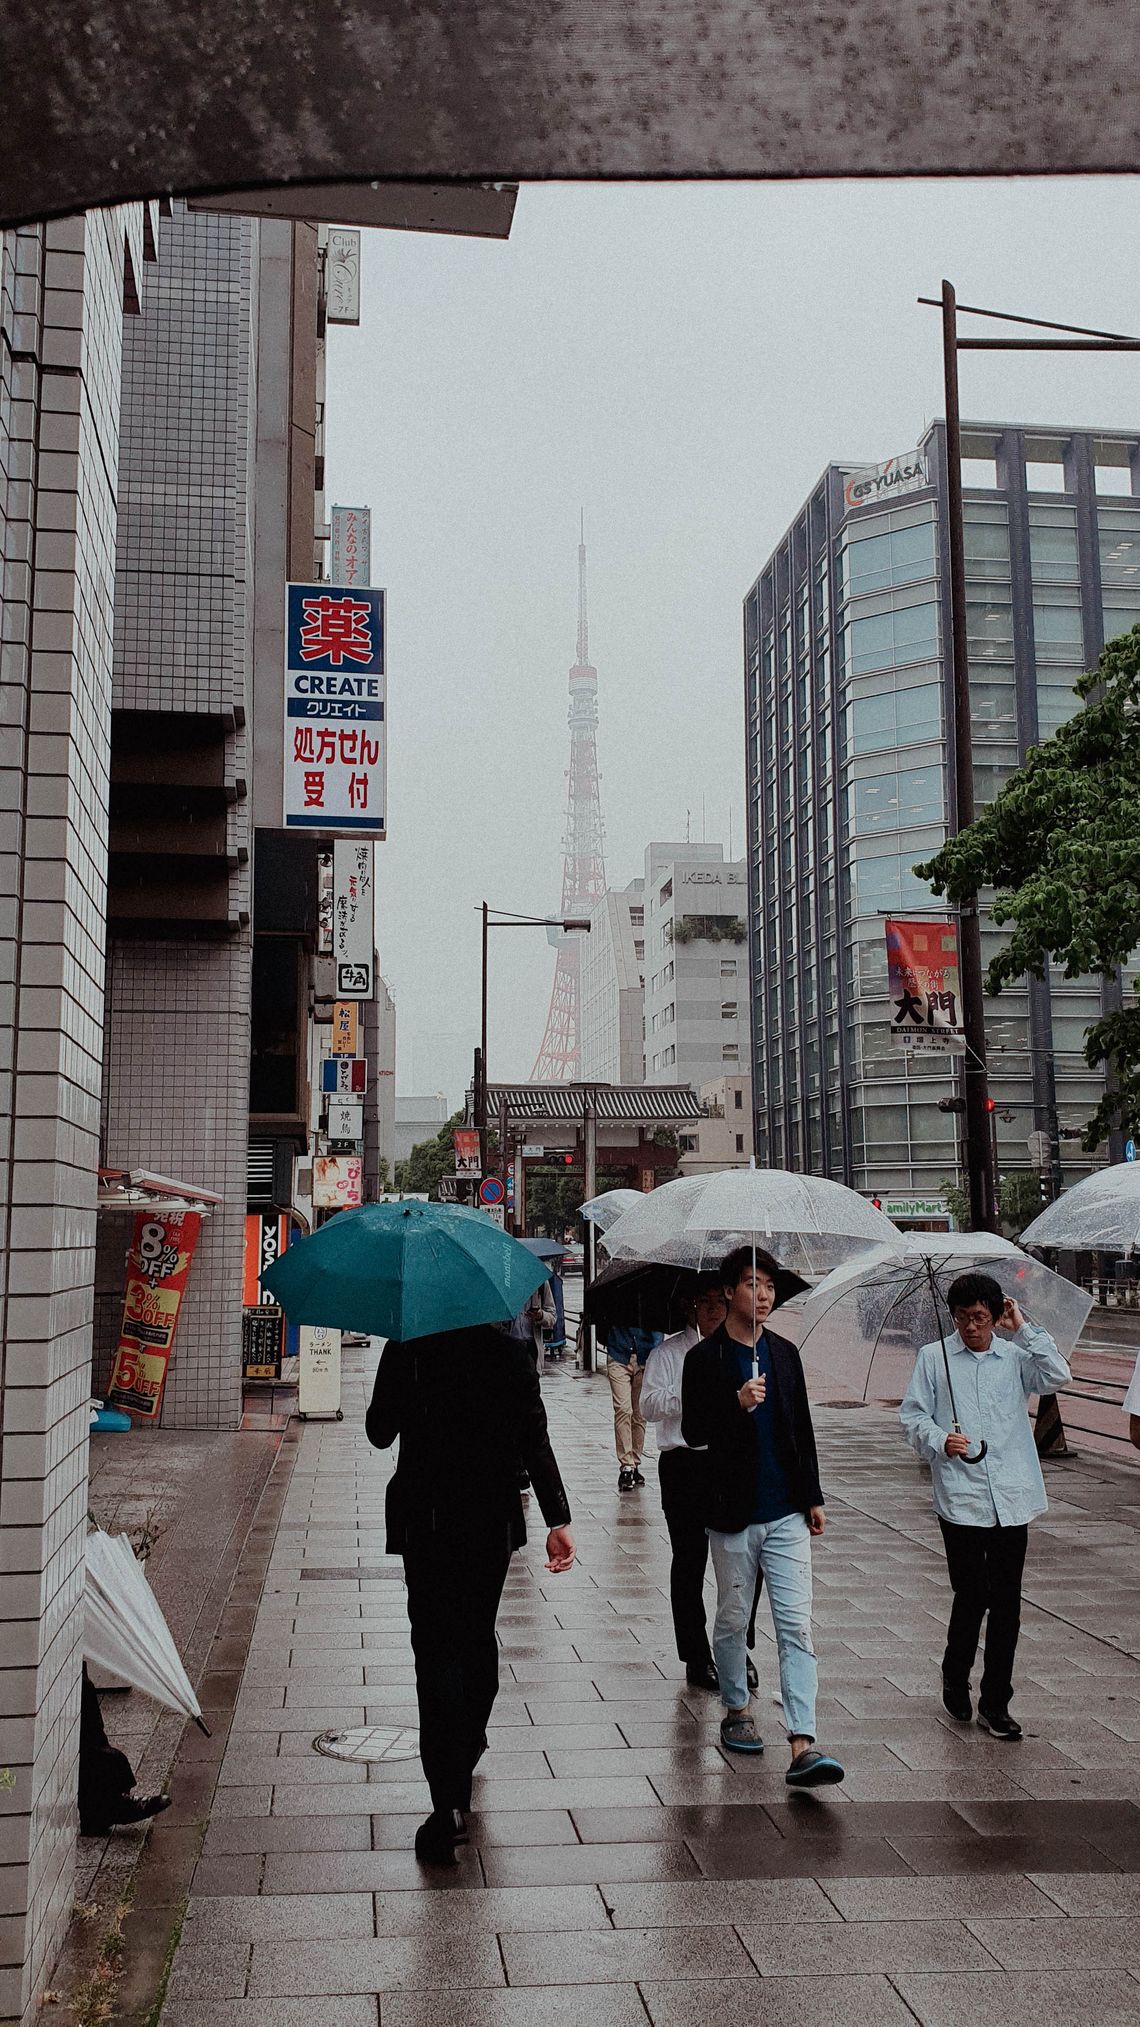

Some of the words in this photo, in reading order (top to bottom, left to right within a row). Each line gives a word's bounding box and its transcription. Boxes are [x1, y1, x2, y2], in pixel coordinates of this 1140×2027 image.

[332, 235, 357, 247] Club
[872, 462, 924, 491] YUASA
[345, 512, 358, 586] みんなのオア
[300, 595, 374, 666] 薬
[294, 674, 379, 698] CREATE
[306, 701, 367, 718] クリエイト
[293, 726, 379, 766] 処方せん
[304, 770, 368, 809] 受付
[682, 871, 722, 885] IKEDA
[343, 969, 366, 986] 牛角
[894, 988, 957, 1027] 大門
[457, 1156, 479, 1168] 大門
[882, 1201, 941, 1215] amilyMart
[143, 1309, 176, 1328] OFF
[310, 1348, 332, 1356] THANK
